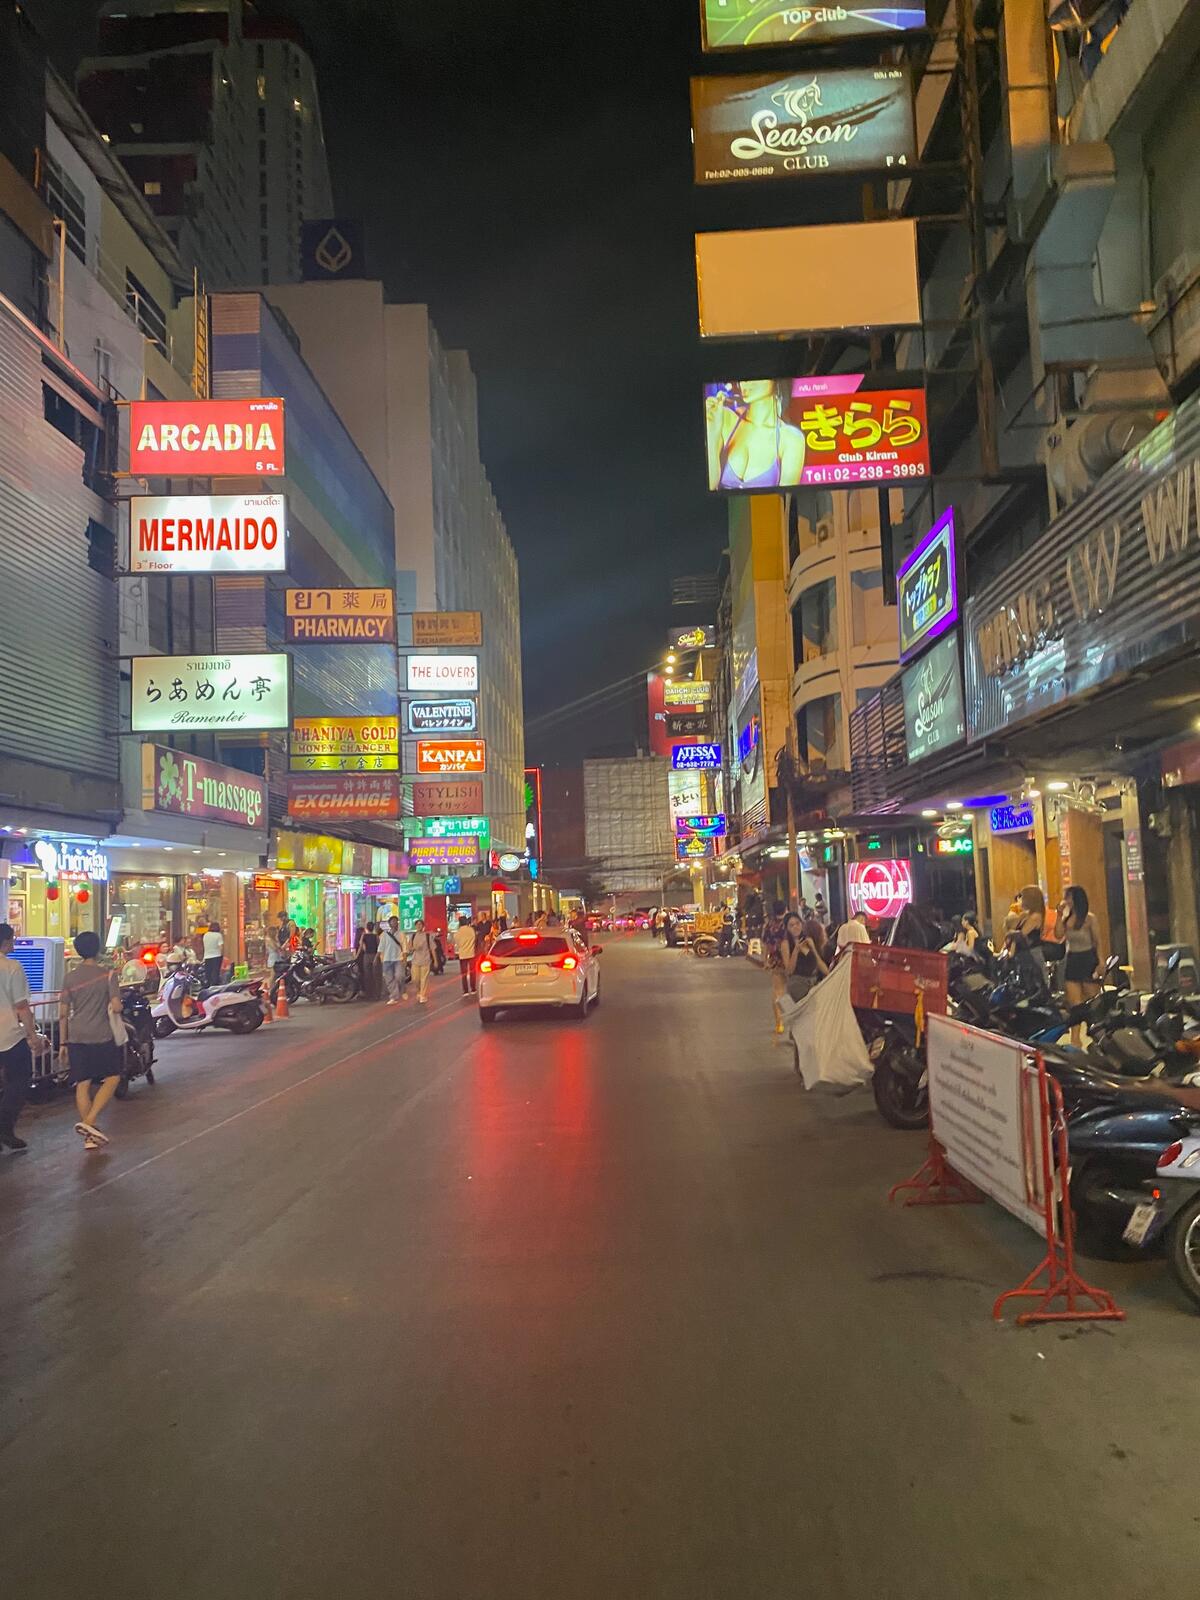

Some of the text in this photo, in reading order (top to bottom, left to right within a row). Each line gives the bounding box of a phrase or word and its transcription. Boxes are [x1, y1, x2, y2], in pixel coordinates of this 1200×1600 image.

[782, 6, 848, 25] TOP club
[730, 109, 859, 160] Season
[783, 155, 829, 171] CLUB
[886, 155, 907, 167] F 4
[800, 399, 922, 451] きらら
[136, 423, 277, 451] ARCADIA
[838, 451, 898, 463] Club Kirara
[256, 462, 263, 471] 5
[139, 516, 278, 551] MERMAIDO
[149, 561, 174, 569] Floor
[294, 591, 331, 610] ยา
[342, 592, 387, 609] 薬局
[294, 617, 388, 638] PHARMACY
[412, 666, 475, 678] THE LOVERS
[144, 676, 272, 703] らあめん亭
[170, 710, 246, 725] Ramentei
[413, 706, 472, 718] VALENTINE
[293, 725, 397, 743] THANIYA GOLD
[298, 743, 391, 753] MONEY CHANGER
[422, 749, 481, 763] KANPAI
[676, 745, 717, 761] ATESSA
[183, 760, 263, 825] T-massage
[294, 792, 392, 808] EXCHANGE
[417, 787, 478, 799] STYLISH
[411, 845, 477, 857] PURPLE DRUGS
[850, 880, 909, 900] U-SMILE
